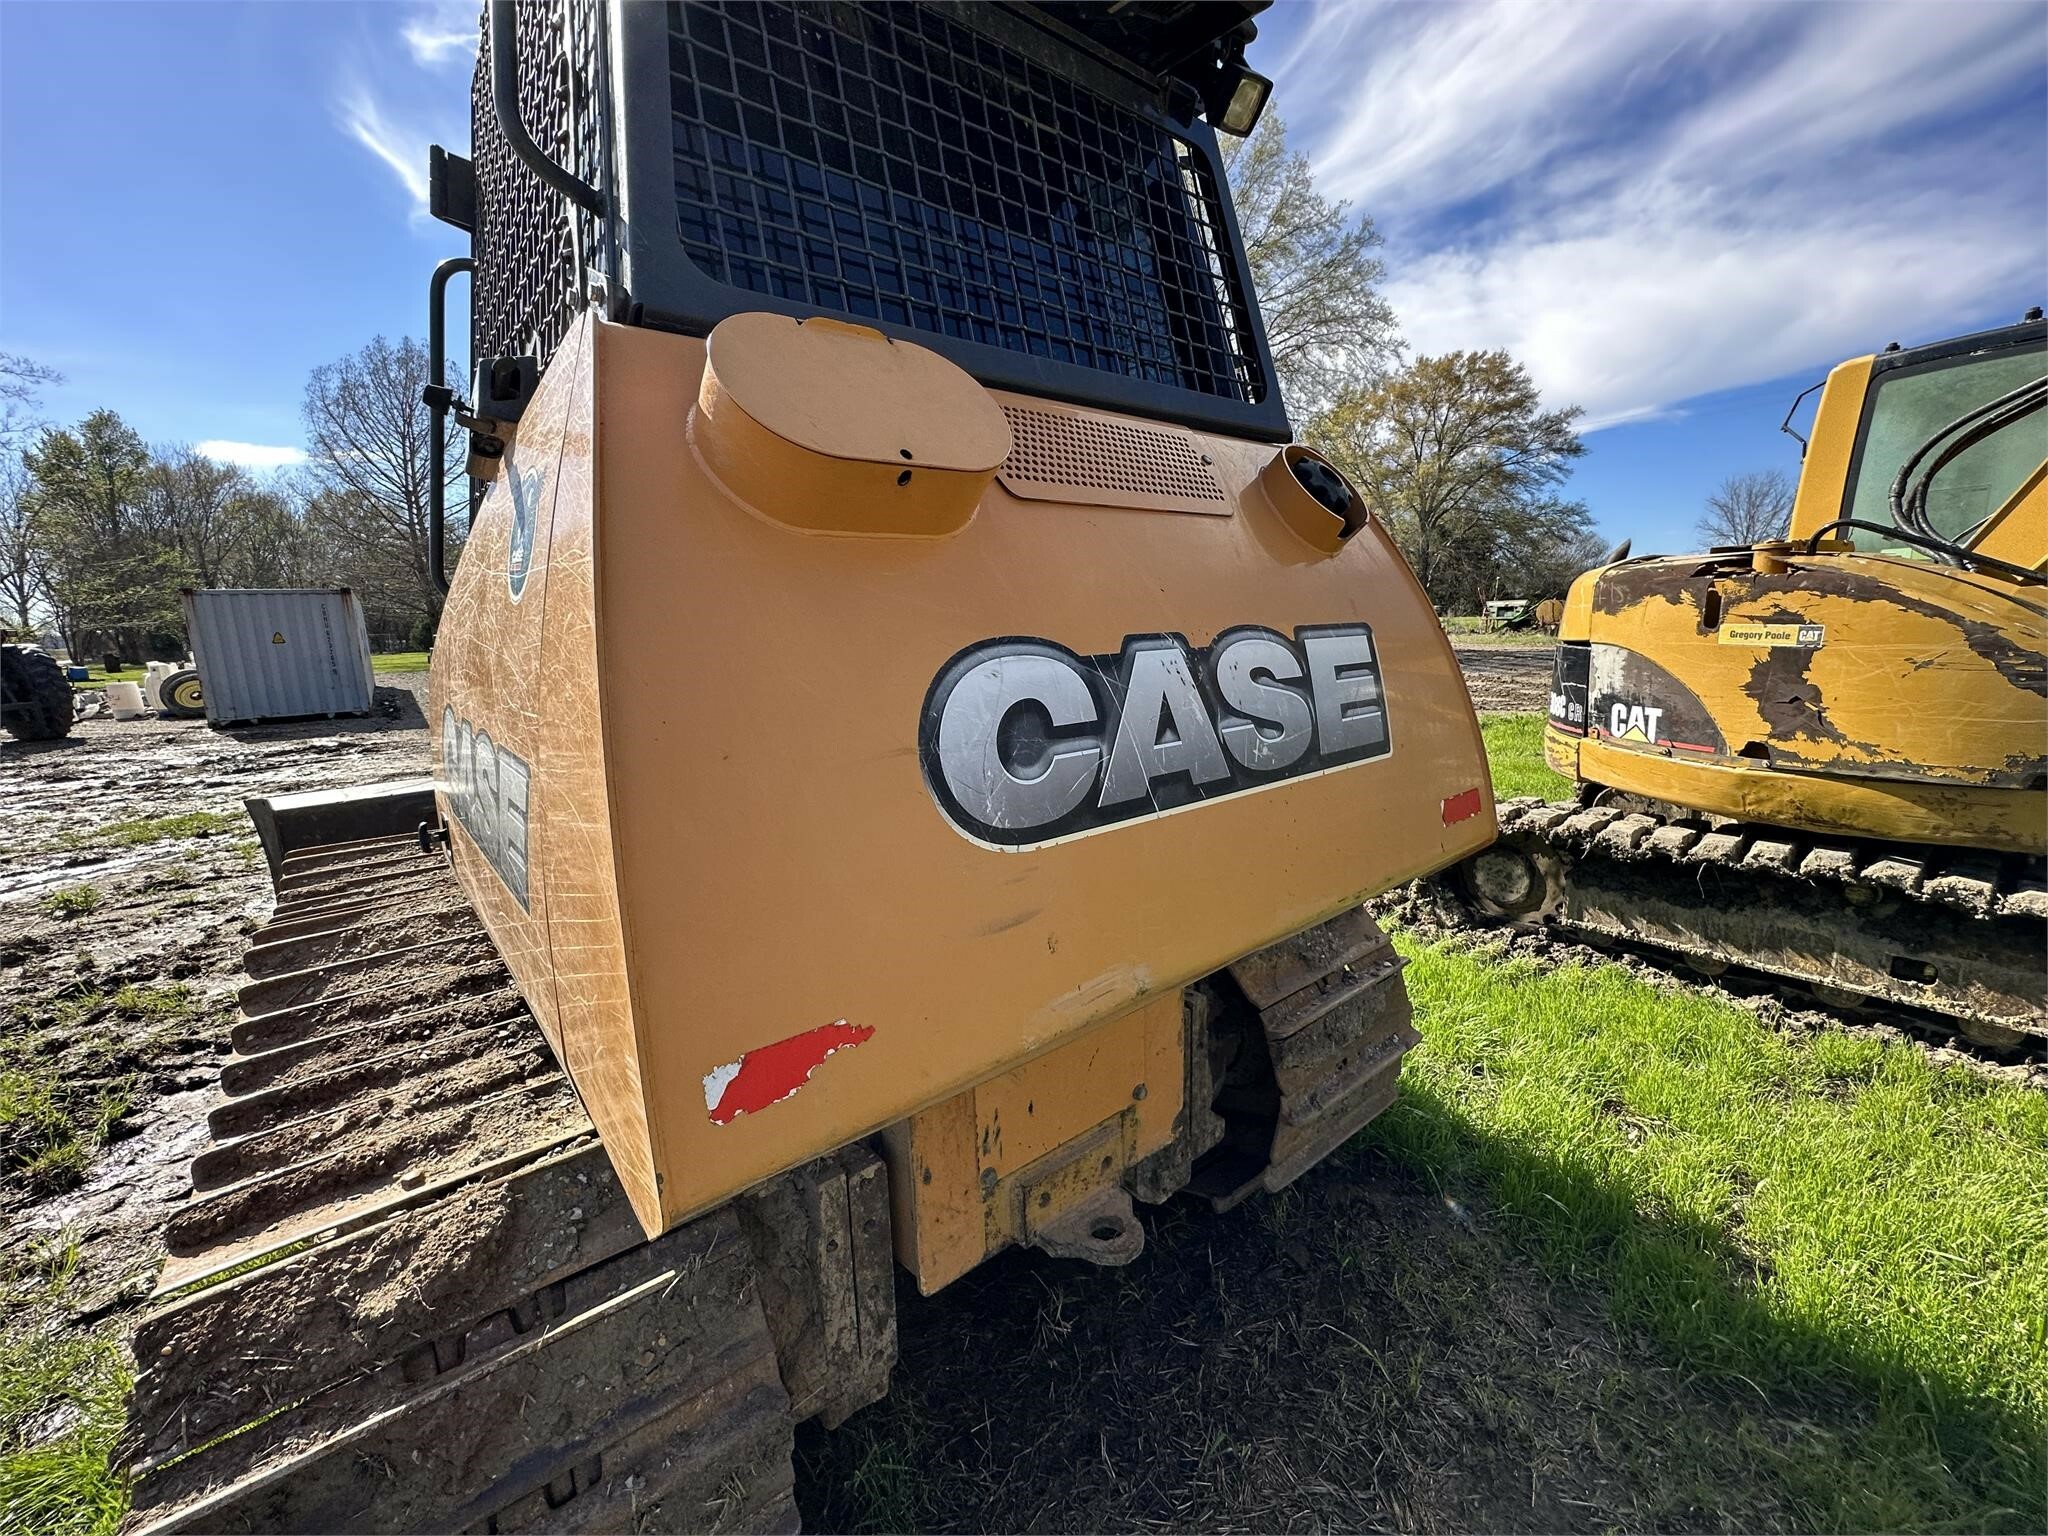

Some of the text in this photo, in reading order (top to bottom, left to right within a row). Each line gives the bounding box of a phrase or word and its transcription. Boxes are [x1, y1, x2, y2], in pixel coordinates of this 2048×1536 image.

[1729, 630, 1791, 640] Gregory Poole
[1798, 630, 1821, 641] CAT
[1567, 702, 1583, 723] CR
[1610, 702, 1663, 745] CAT
[938, 633, 1386, 830] CASE
[442, 704, 529, 897] CASE
